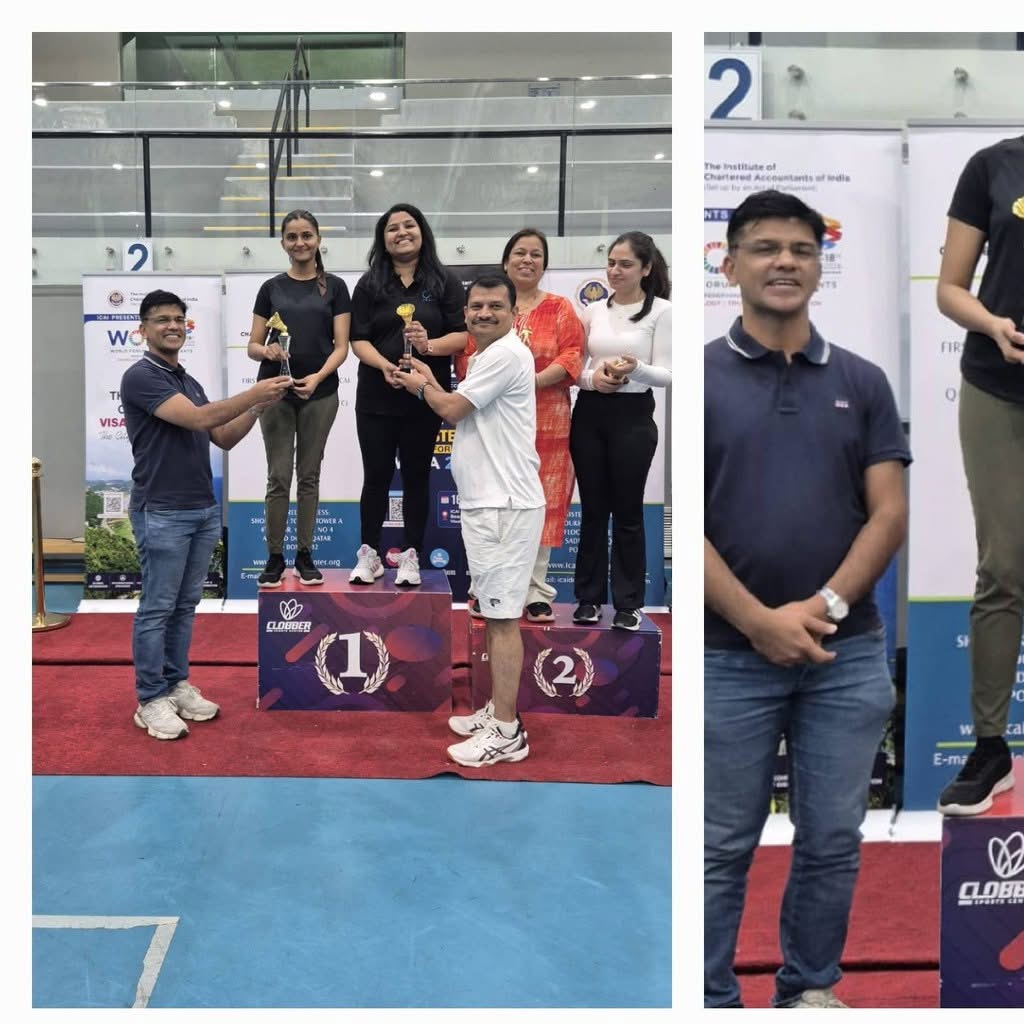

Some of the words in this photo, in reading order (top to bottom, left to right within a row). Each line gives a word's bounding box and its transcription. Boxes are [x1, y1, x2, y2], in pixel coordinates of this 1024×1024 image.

[708, 58, 752, 120] 2
[754, 174, 813, 182] Accountants
[816, 174, 826, 182] of
[828, 174, 850, 182] India
[128, 243, 149, 271] 2
[339, 632, 368, 678] 1
[552, 655, 577, 684] 2
